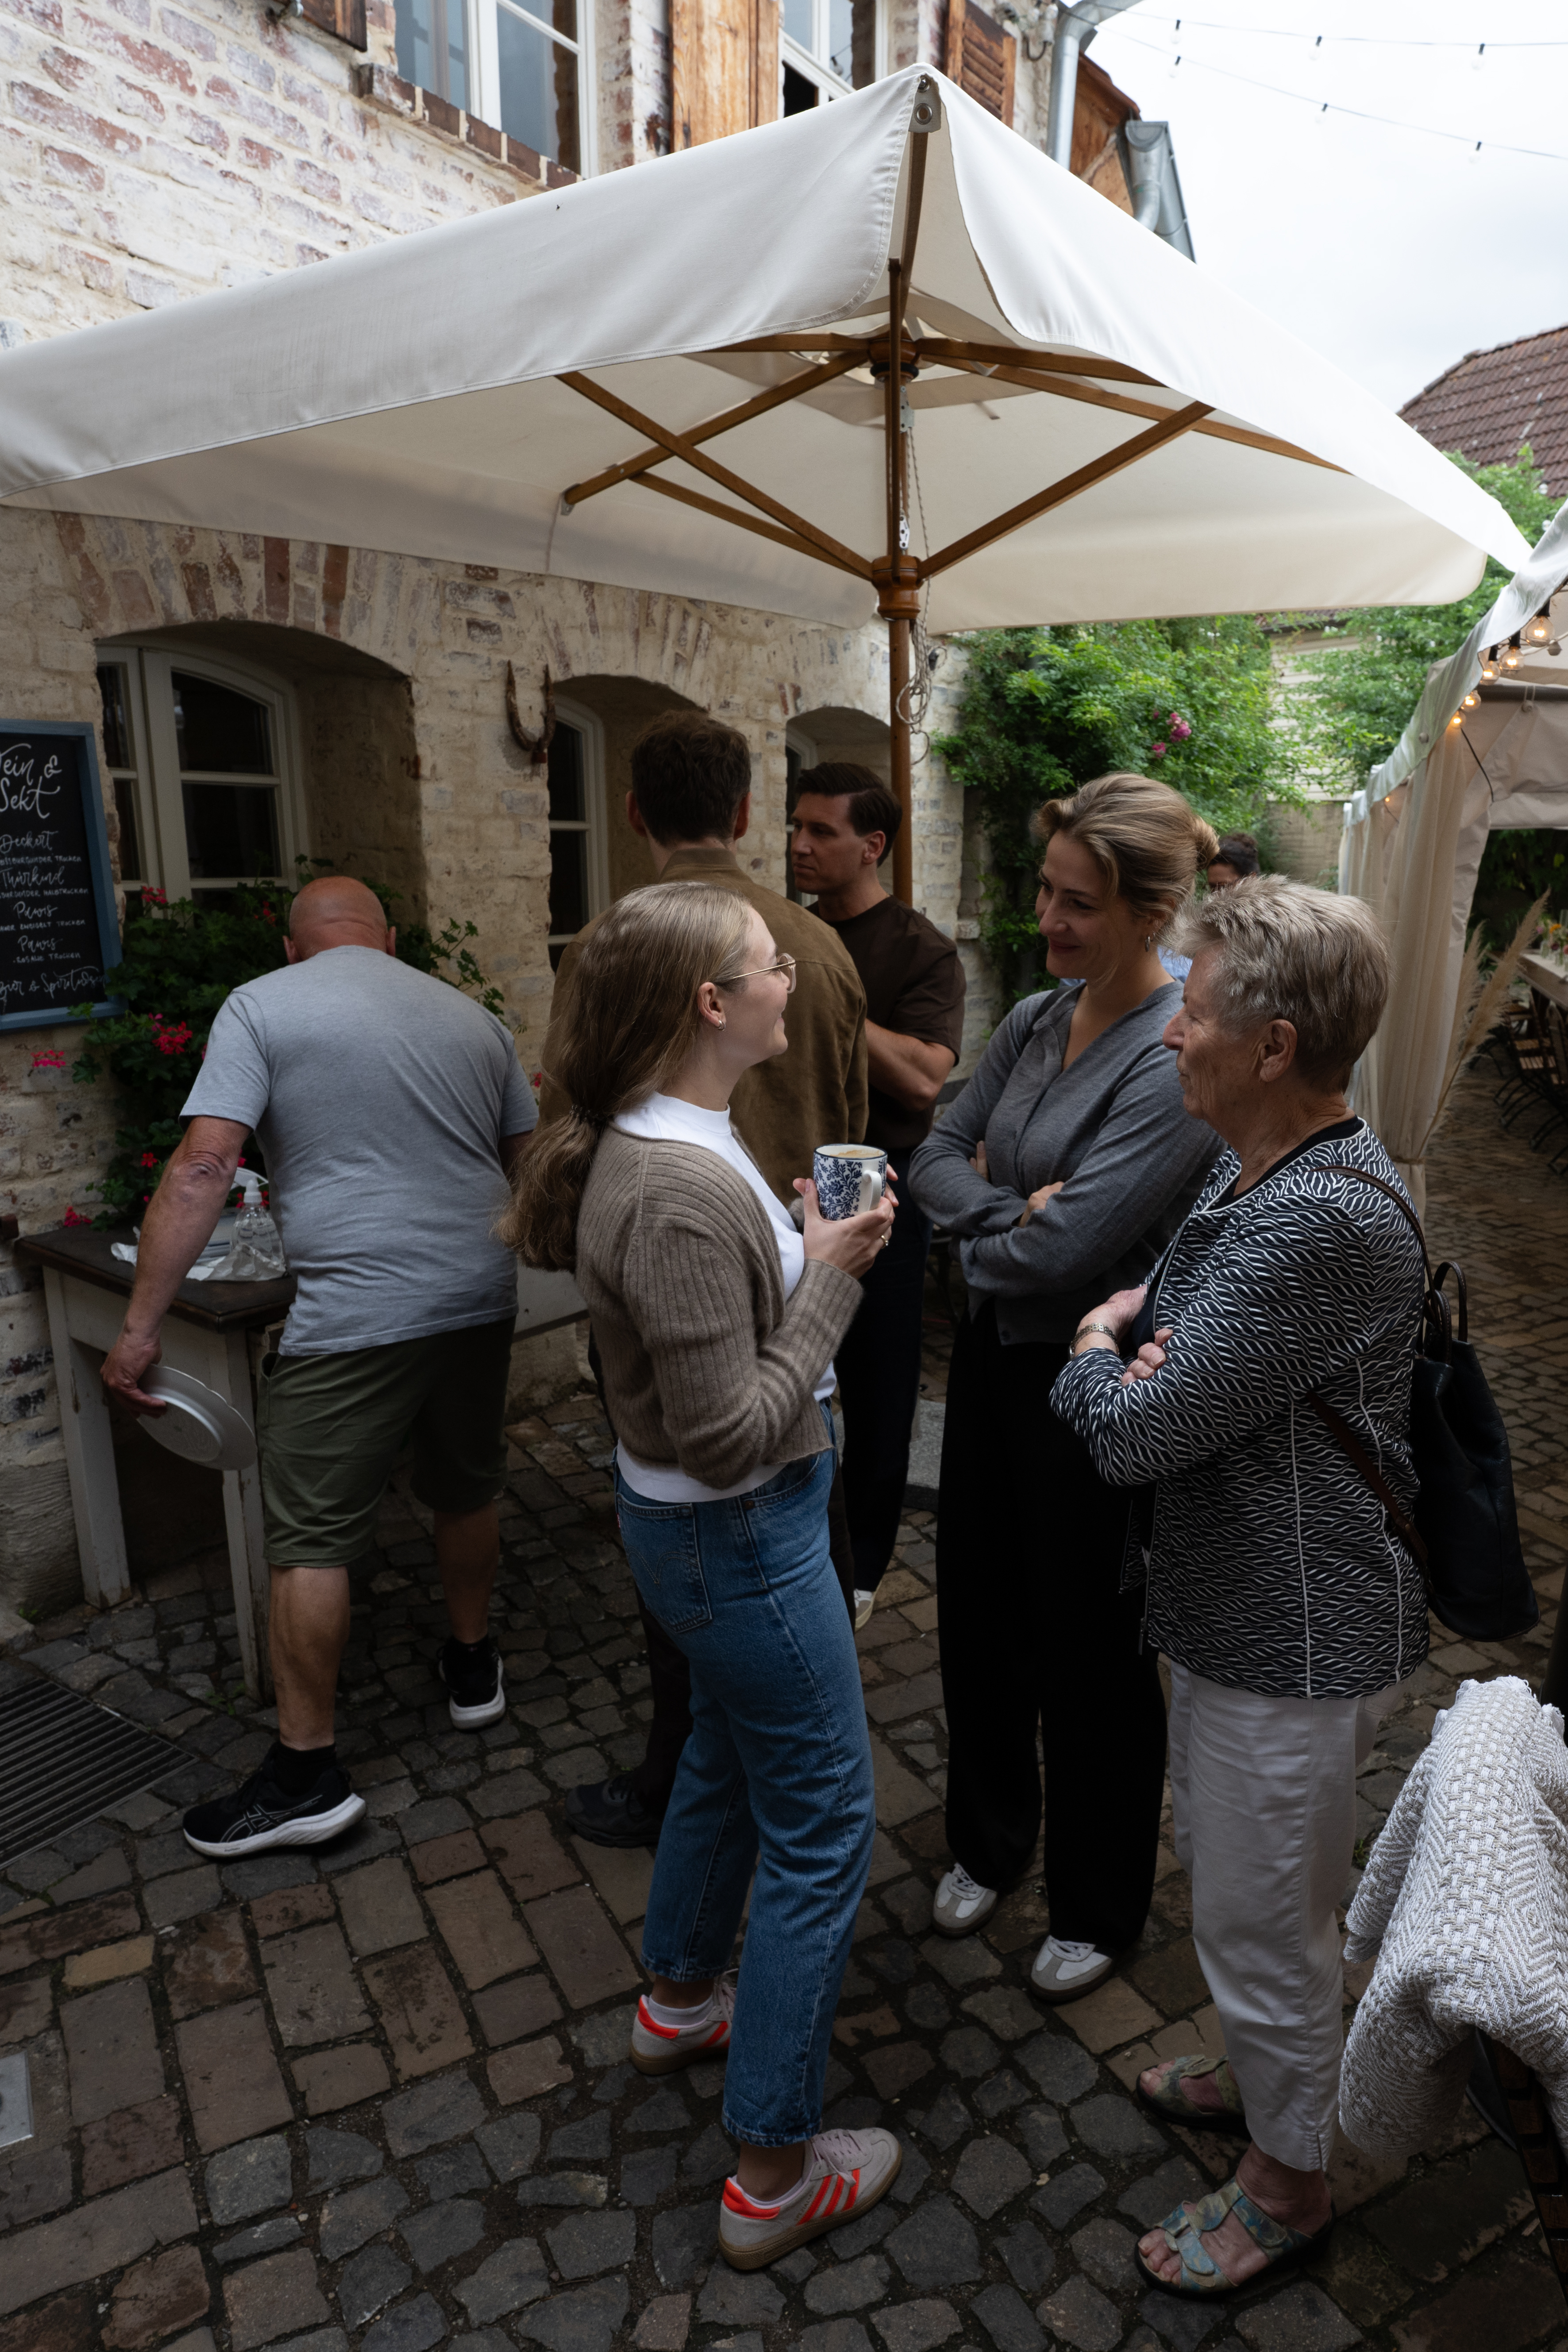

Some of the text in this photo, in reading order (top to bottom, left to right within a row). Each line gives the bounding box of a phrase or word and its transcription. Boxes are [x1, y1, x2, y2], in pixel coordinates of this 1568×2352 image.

[44, 755, 62, 779] &
[0, 775, 61, 819] Sekt
[29, 979, 40, 991] &
